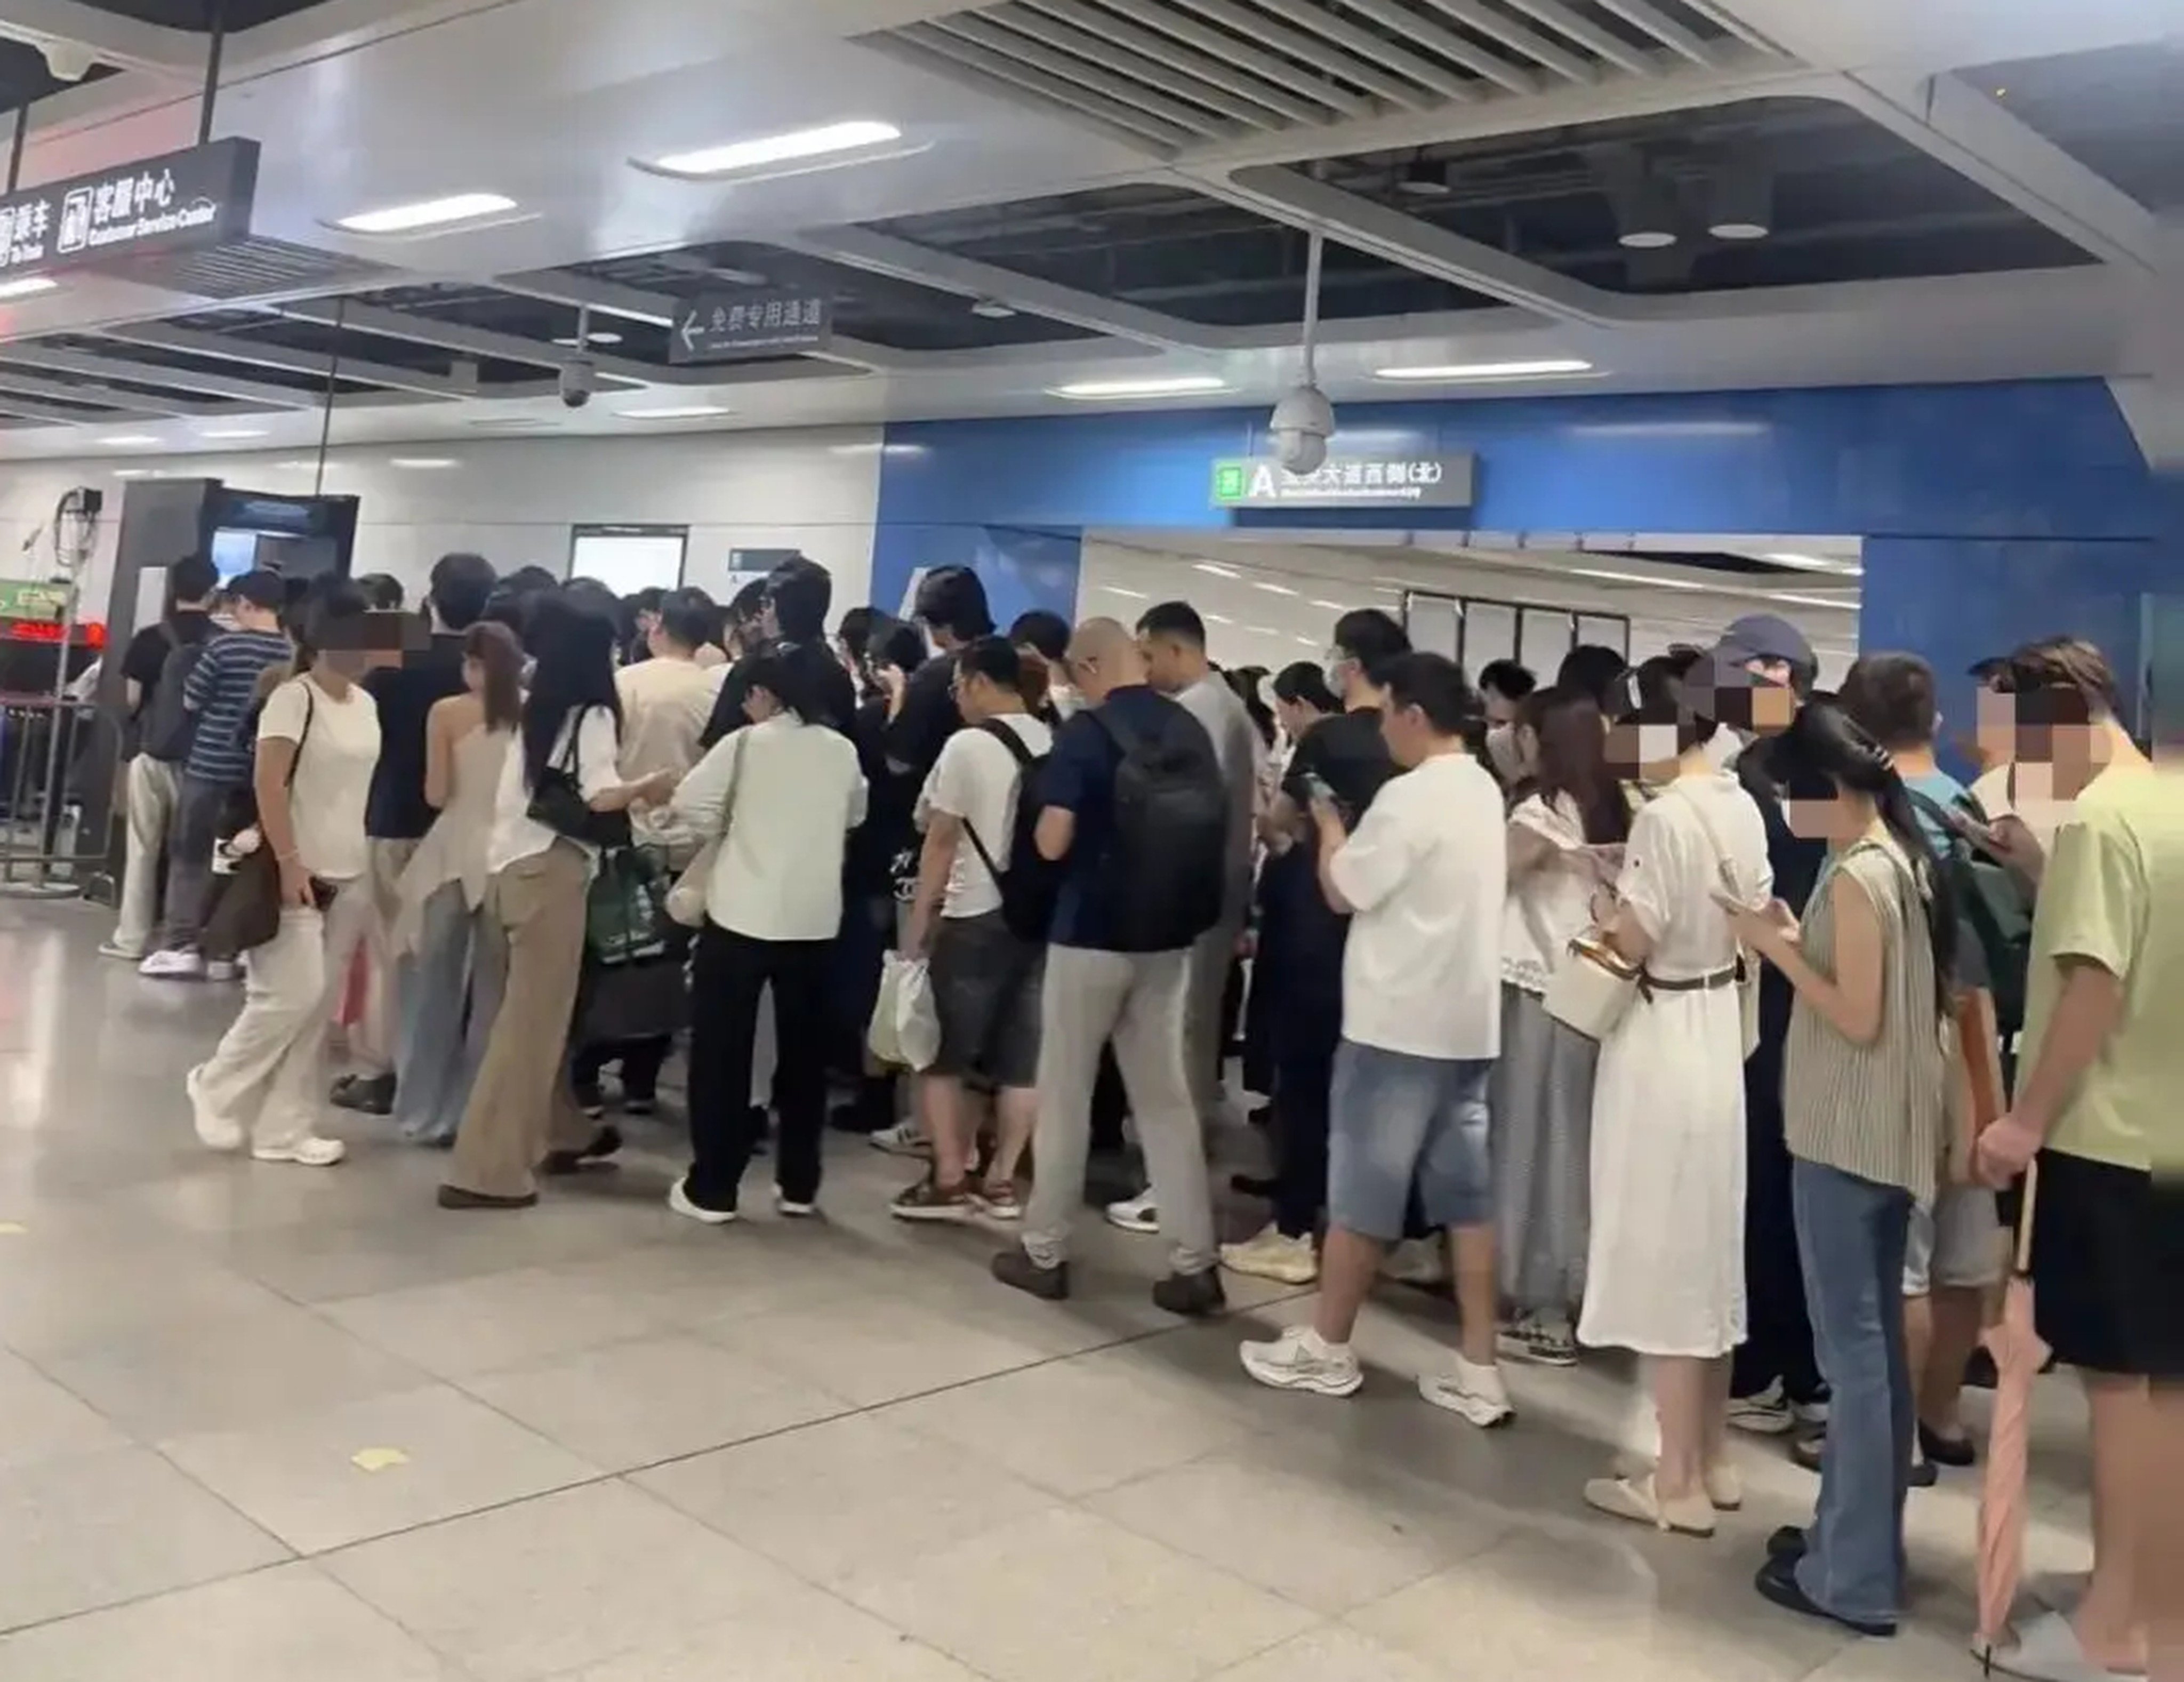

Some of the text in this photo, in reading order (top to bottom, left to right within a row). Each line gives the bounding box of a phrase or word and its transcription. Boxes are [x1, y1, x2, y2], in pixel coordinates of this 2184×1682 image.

[94, 168, 175, 225] 客服中心
[1248, 464, 1277, 498] A
